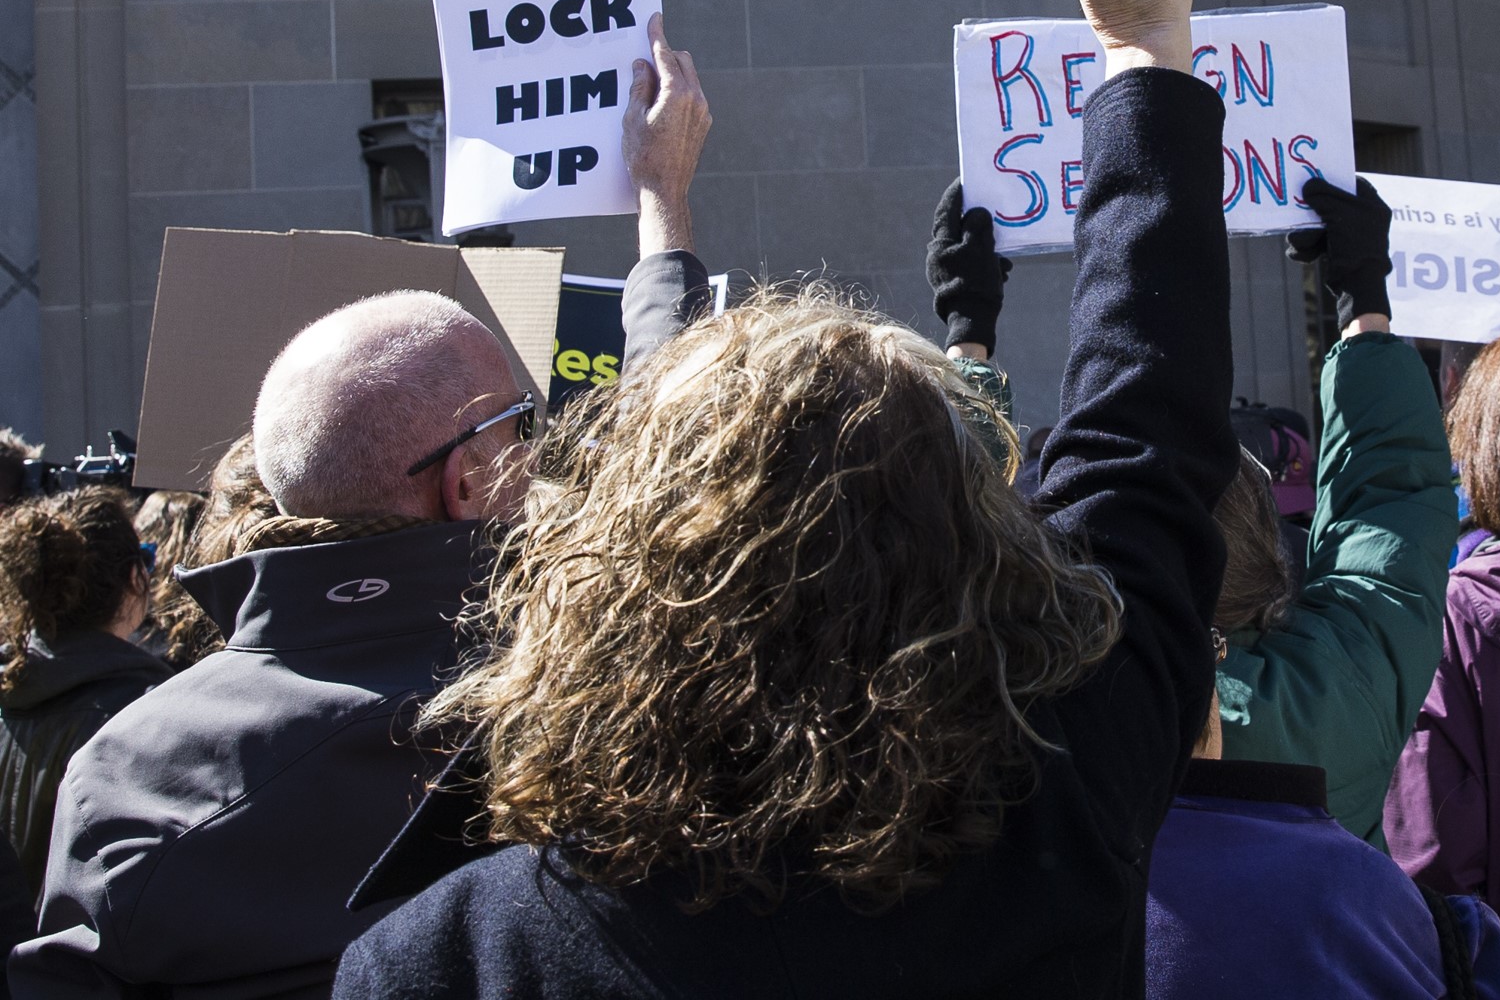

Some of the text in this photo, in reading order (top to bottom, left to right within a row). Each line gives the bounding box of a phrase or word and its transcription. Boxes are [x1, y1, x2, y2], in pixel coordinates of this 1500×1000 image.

[496, 69, 618, 125] HIM
[990, 30, 1275, 131] REGN
[513, 146, 599, 190] UP
[993, 134, 1326, 228] SEONS
